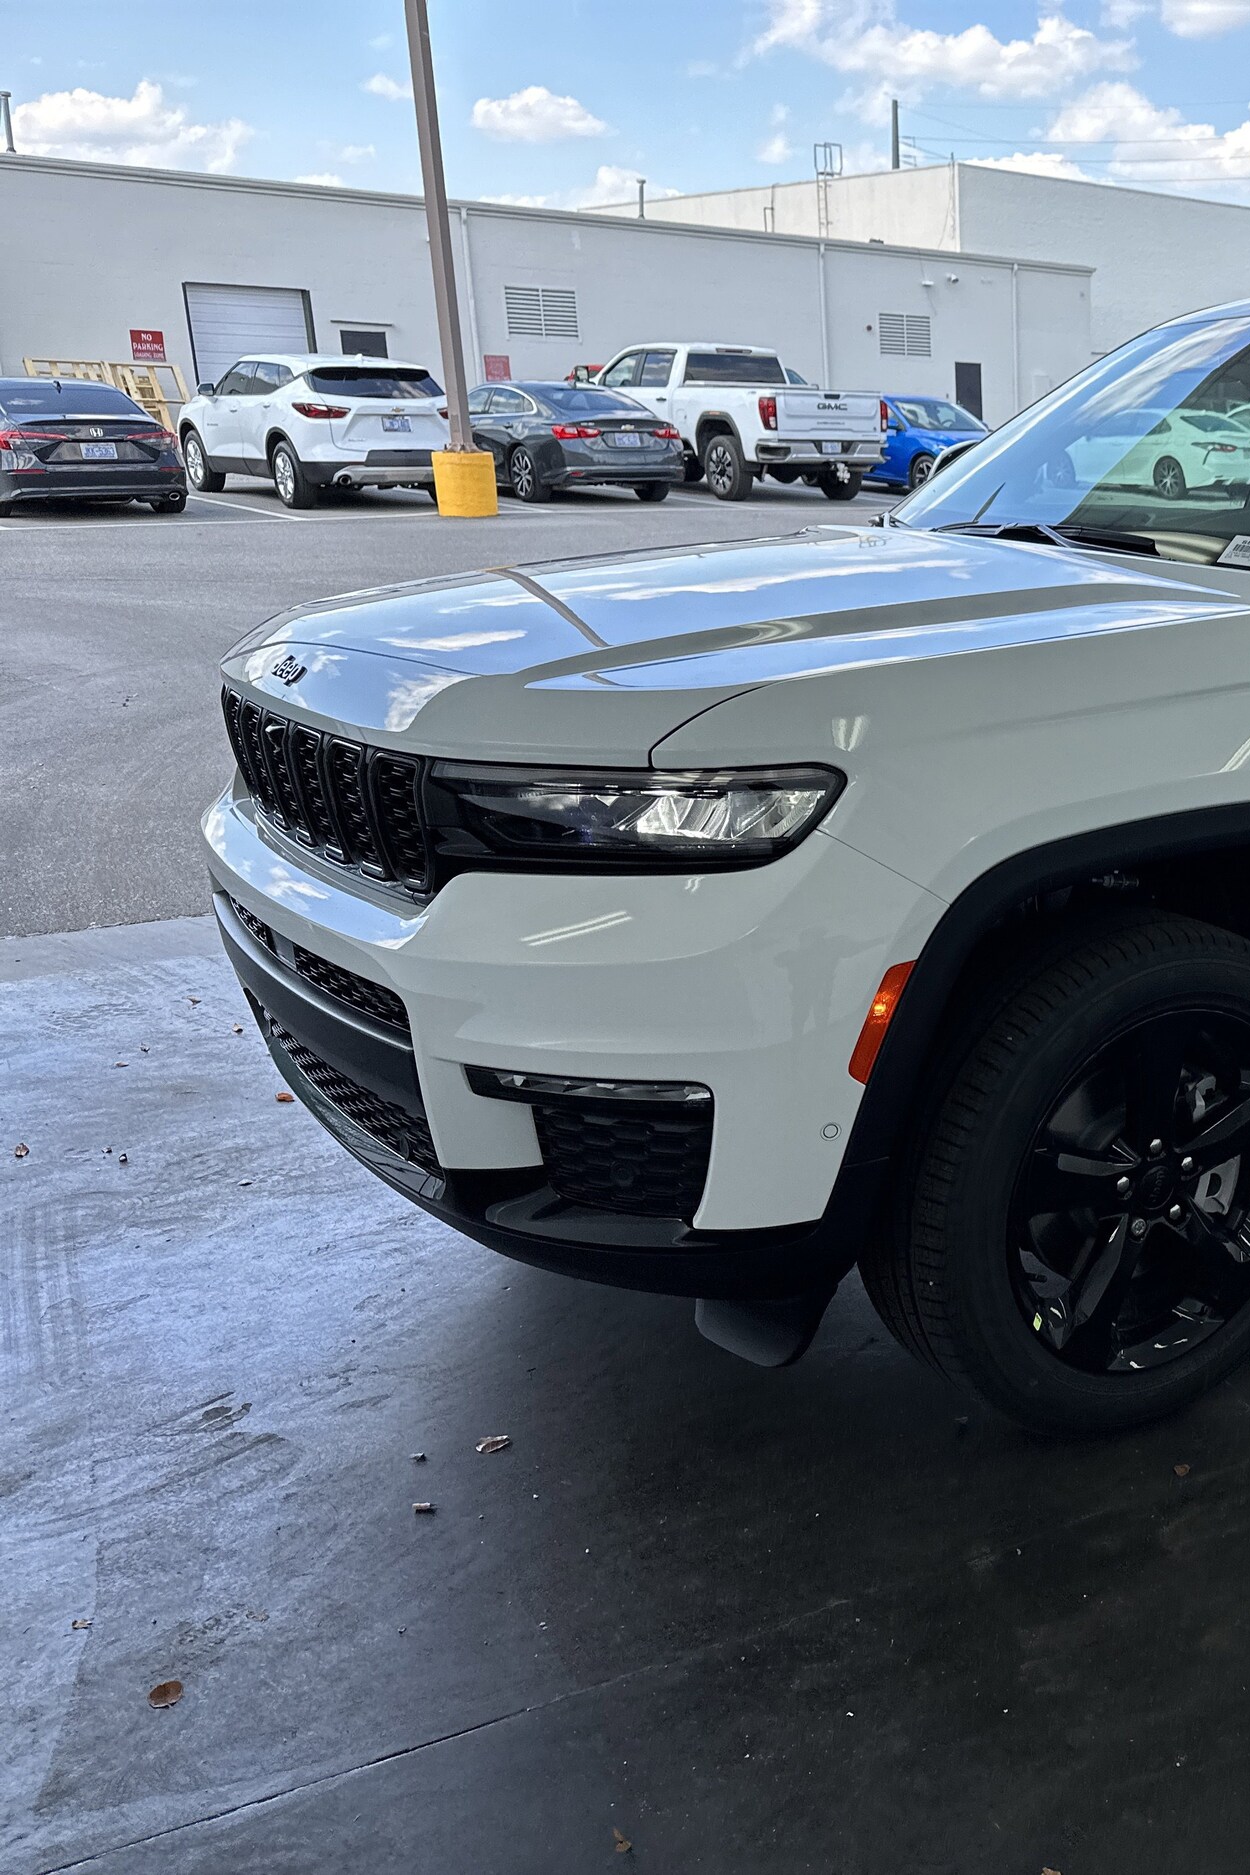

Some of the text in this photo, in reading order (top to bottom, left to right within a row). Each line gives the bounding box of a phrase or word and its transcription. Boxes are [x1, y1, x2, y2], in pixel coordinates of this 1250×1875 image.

[141, 333, 153, 341] NO
[132, 342, 164, 352] PARKING
[817, 402, 848, 411] GMC
[271, 654, 308, 687] Jeep
